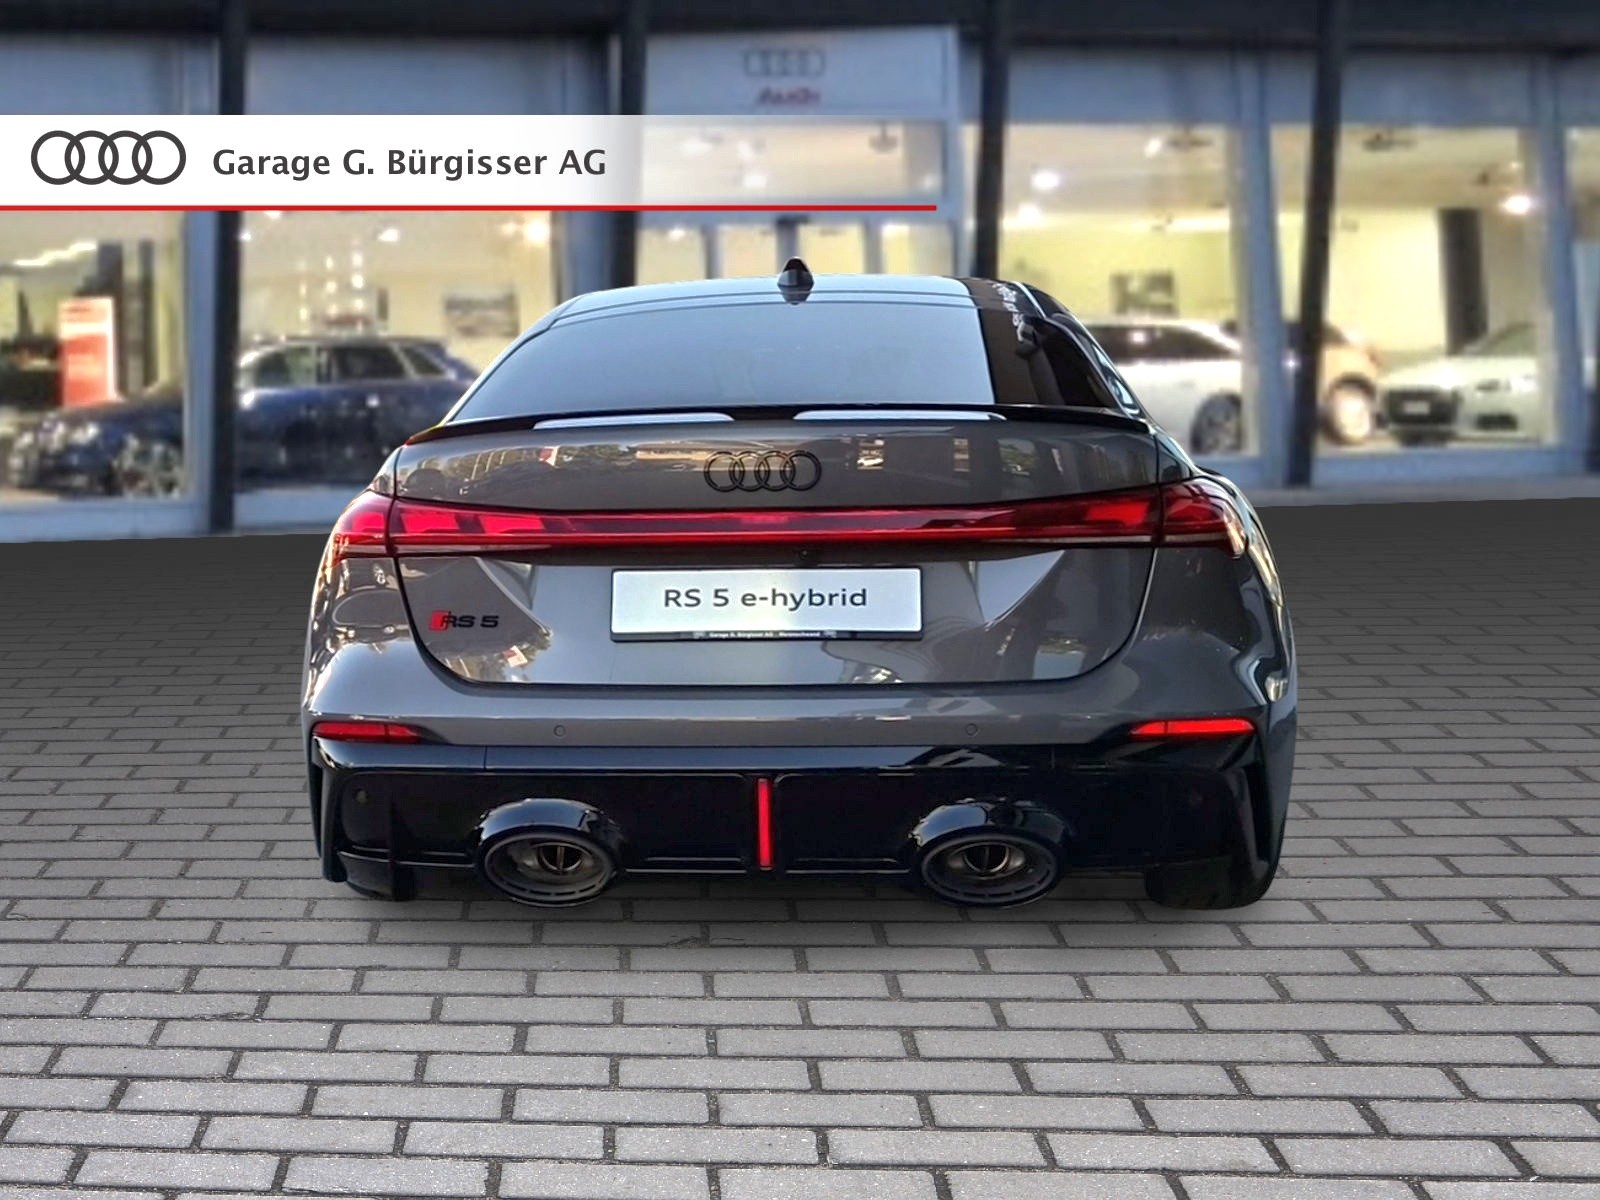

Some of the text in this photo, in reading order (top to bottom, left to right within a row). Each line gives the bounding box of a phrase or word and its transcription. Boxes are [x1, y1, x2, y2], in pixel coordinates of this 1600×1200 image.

[664, 588, 867, 612] RS 5 e-hybrid
[438, 612, 500, 629] RS 5
